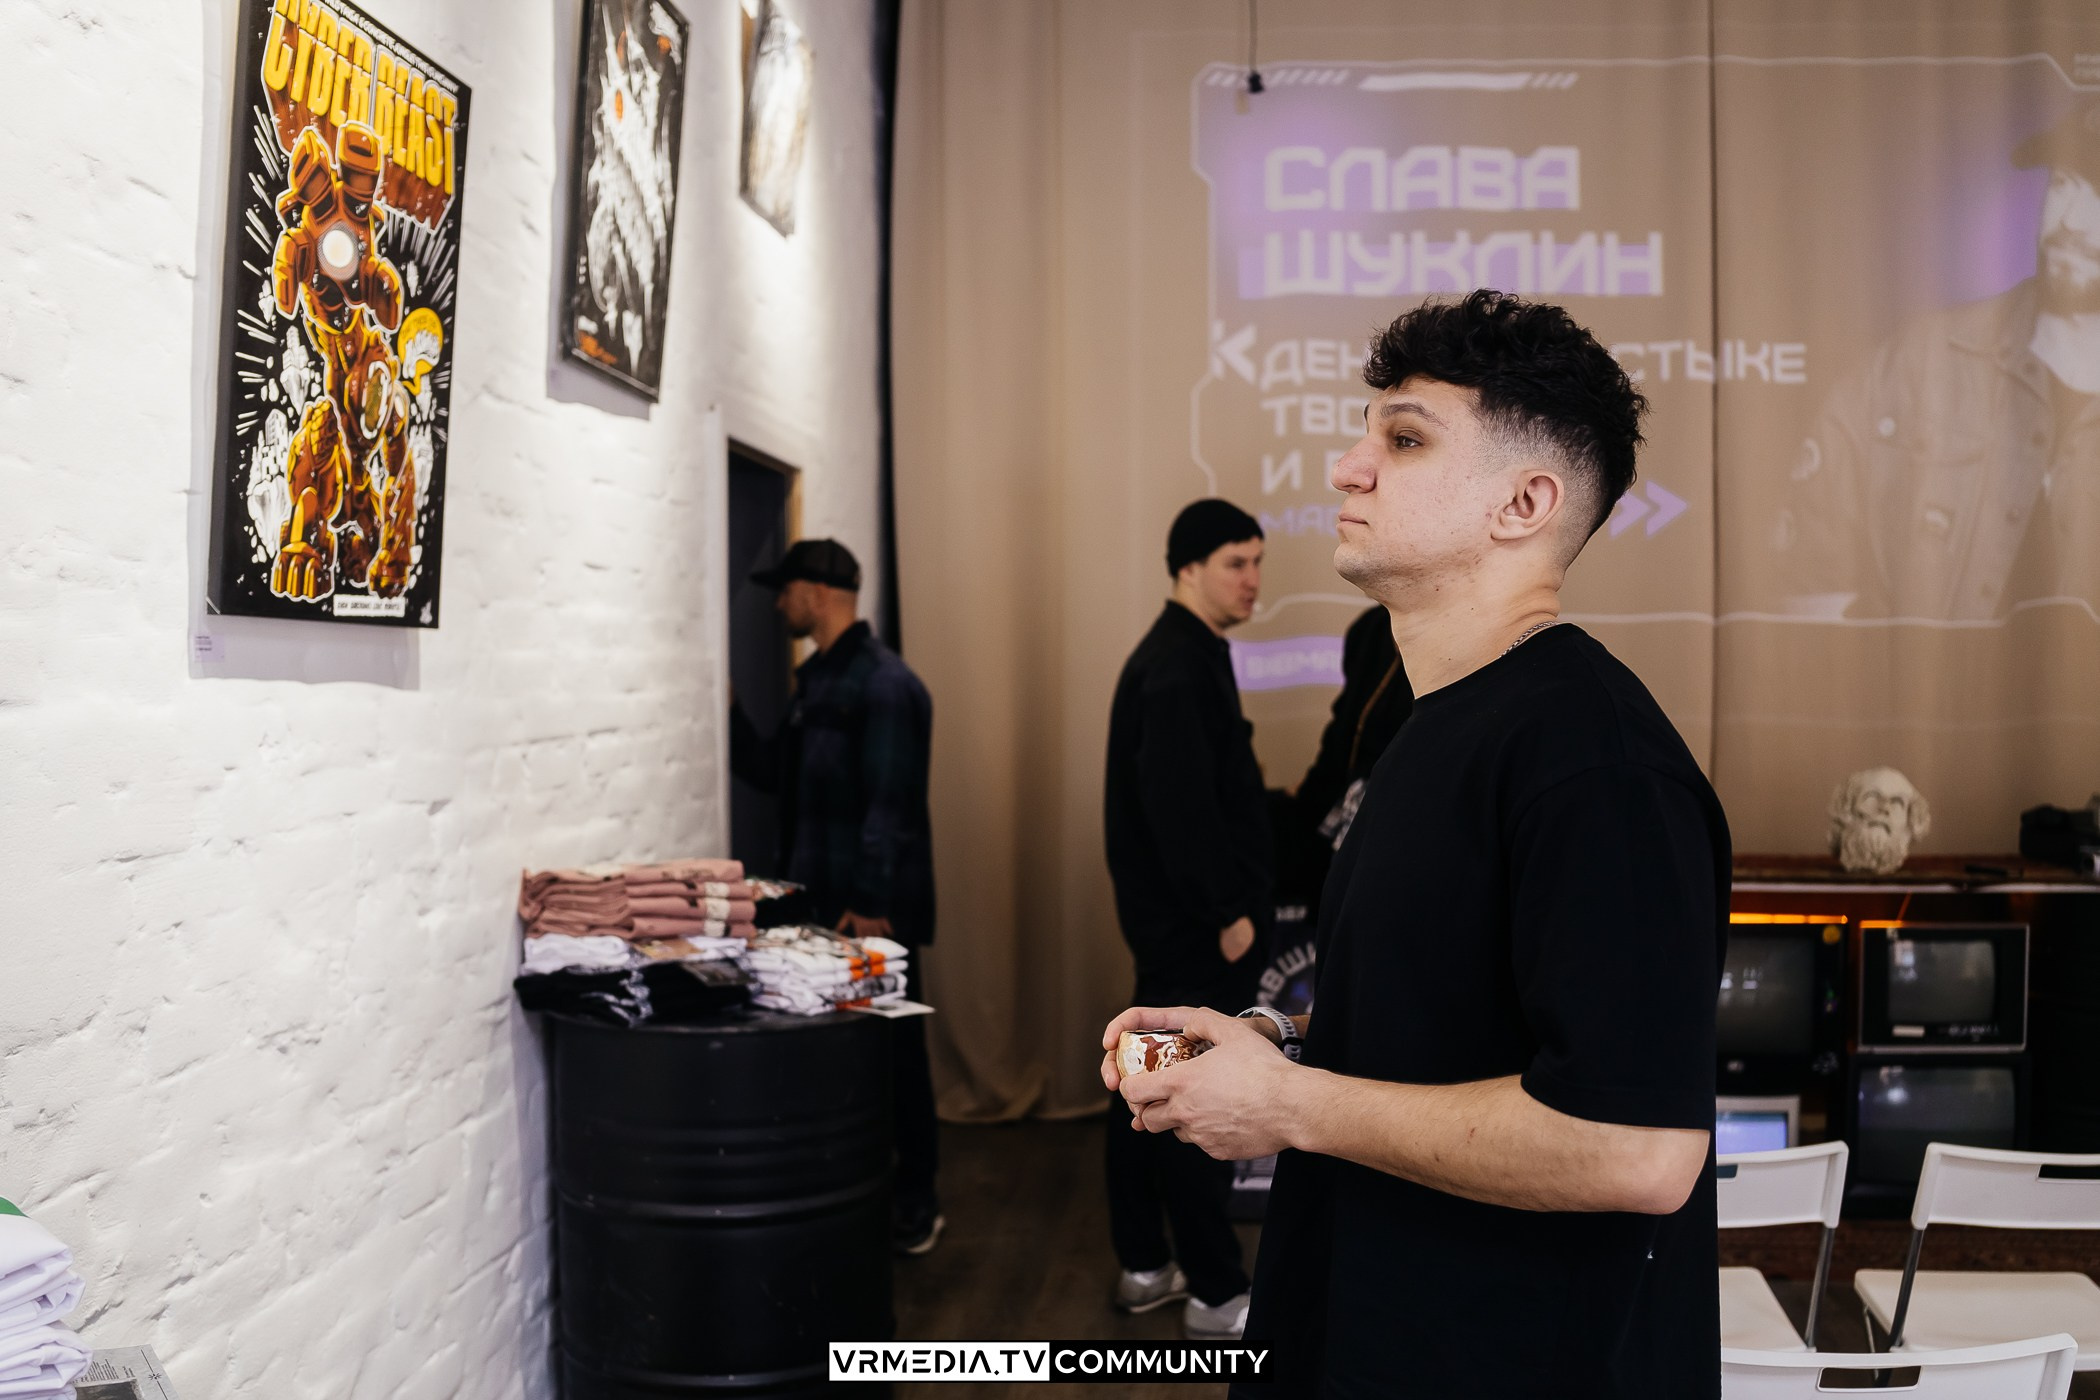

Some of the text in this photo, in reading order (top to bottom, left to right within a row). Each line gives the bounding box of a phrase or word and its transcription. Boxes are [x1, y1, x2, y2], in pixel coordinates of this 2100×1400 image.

[1264, 145, 1581, 211] СЛАВА
[1263, 231, 1664, 297] ШУКЛИН
[1260, 338, 1367, 392] ДЕН
[1261, 393, 1369, 437] ТВО
